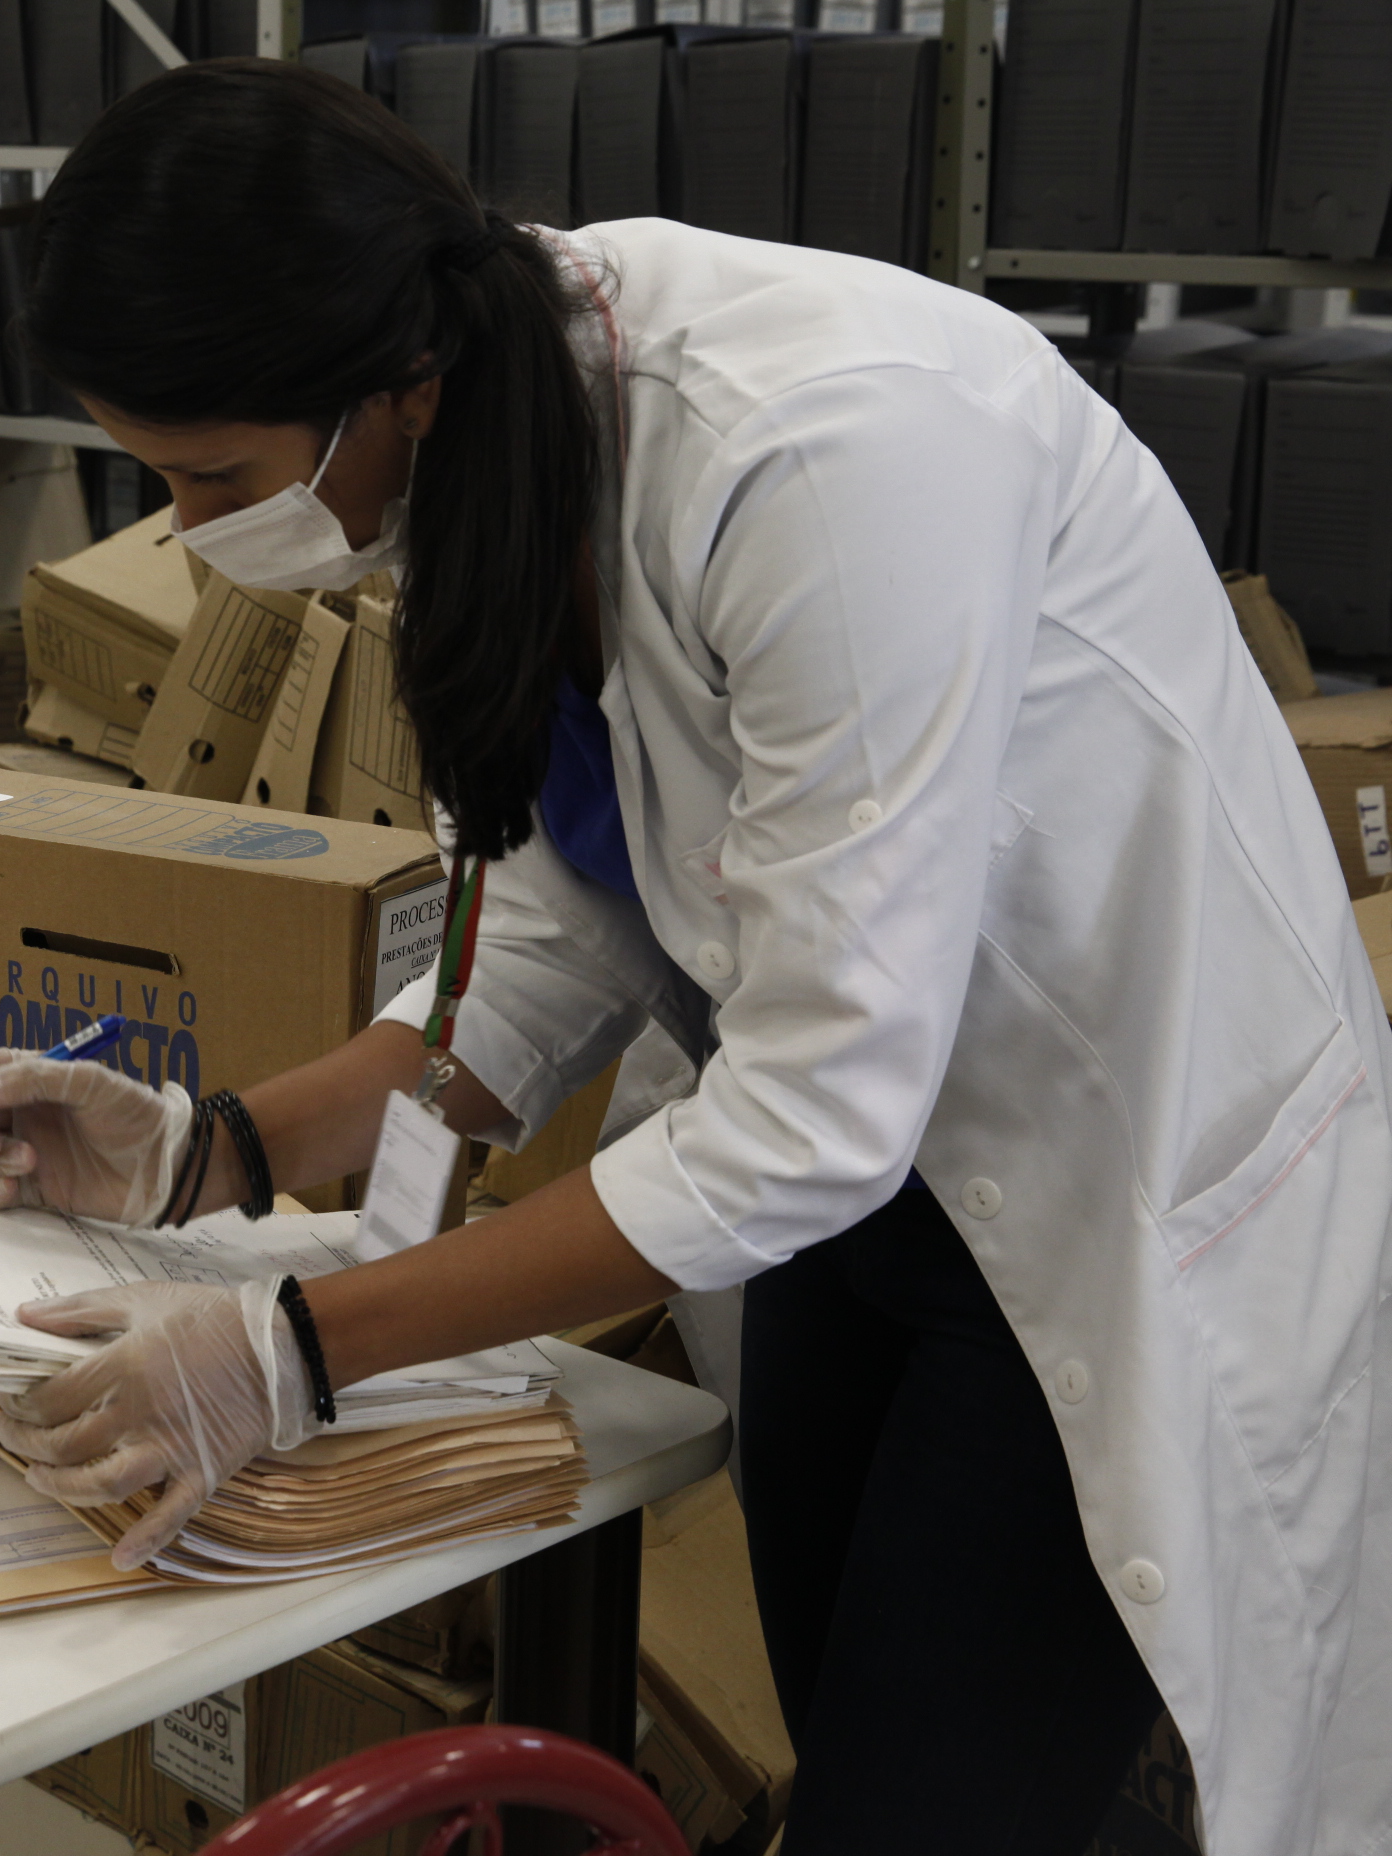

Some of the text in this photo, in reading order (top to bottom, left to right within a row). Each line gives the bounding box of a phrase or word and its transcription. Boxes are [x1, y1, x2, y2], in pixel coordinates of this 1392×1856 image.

[381, 932, 443, 964] PRESTAÇÕES DE
[411, 953, 431, 967] CAIXA
[173, 1702, 227, 1739] 009
[163, 1718, 199, 1747] CAIXA
[219, 1749, 234, 1765] 24
